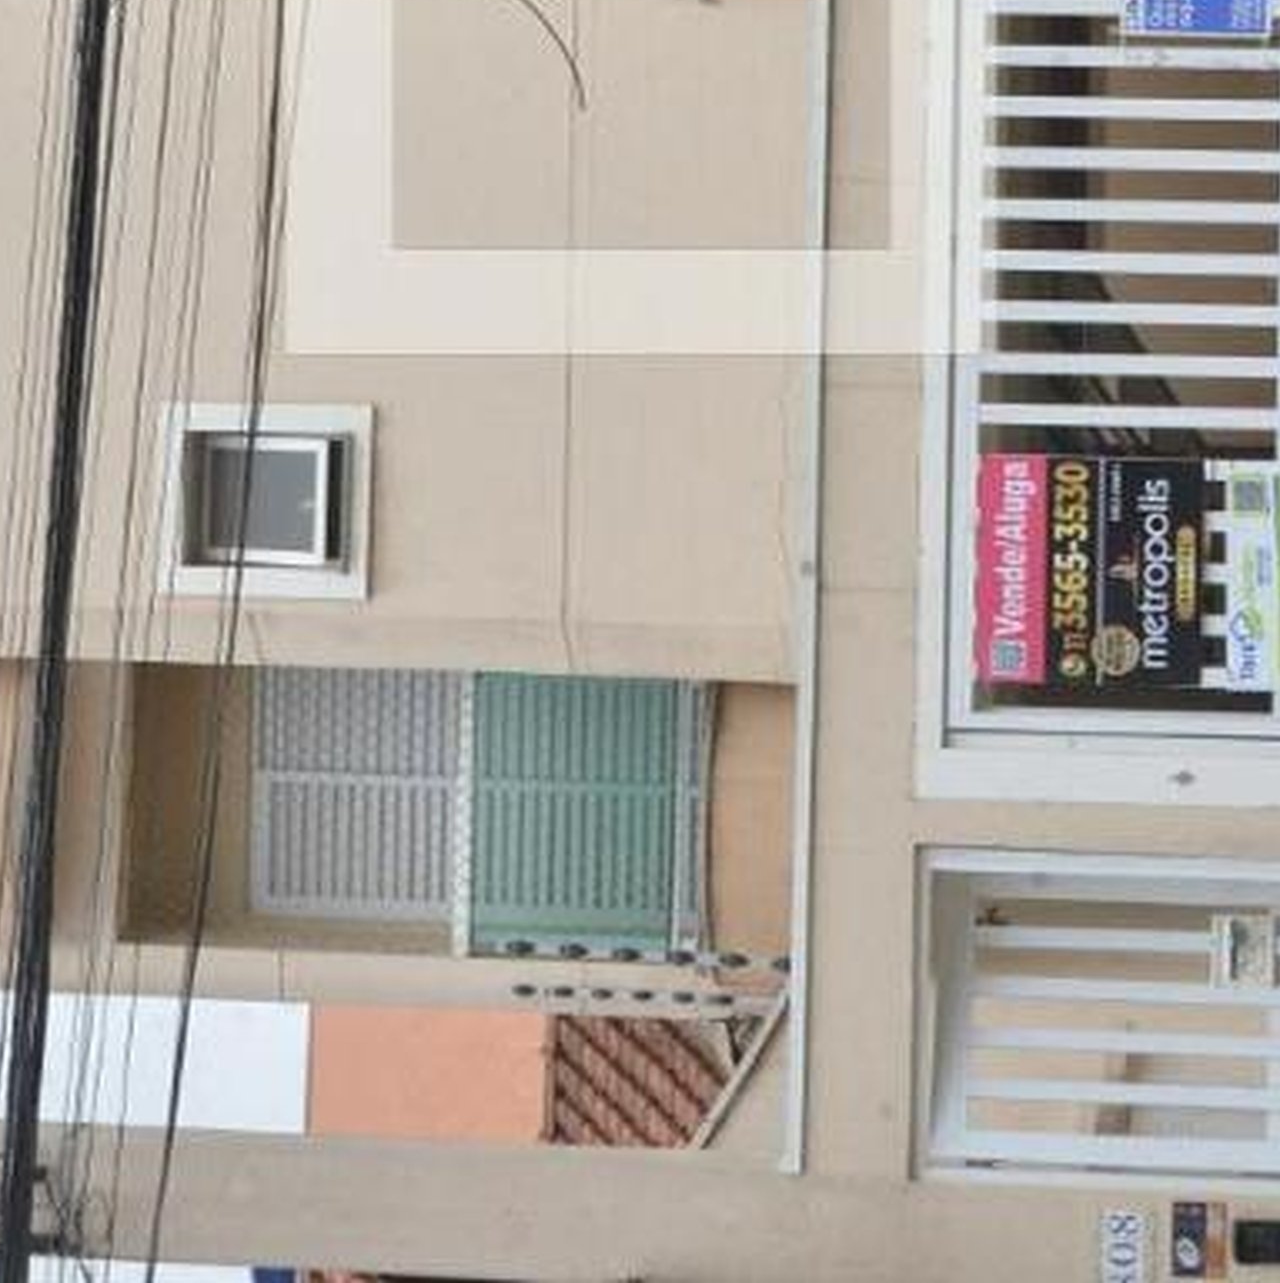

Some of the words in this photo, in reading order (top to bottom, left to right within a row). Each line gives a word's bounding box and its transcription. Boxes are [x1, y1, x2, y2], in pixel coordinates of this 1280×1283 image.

[993, 459, 1034, 636] Vende/Aluga
[1053, 463, 1090, 629] 3565-3530
[1137, 478, 1171, 671] metropolis
